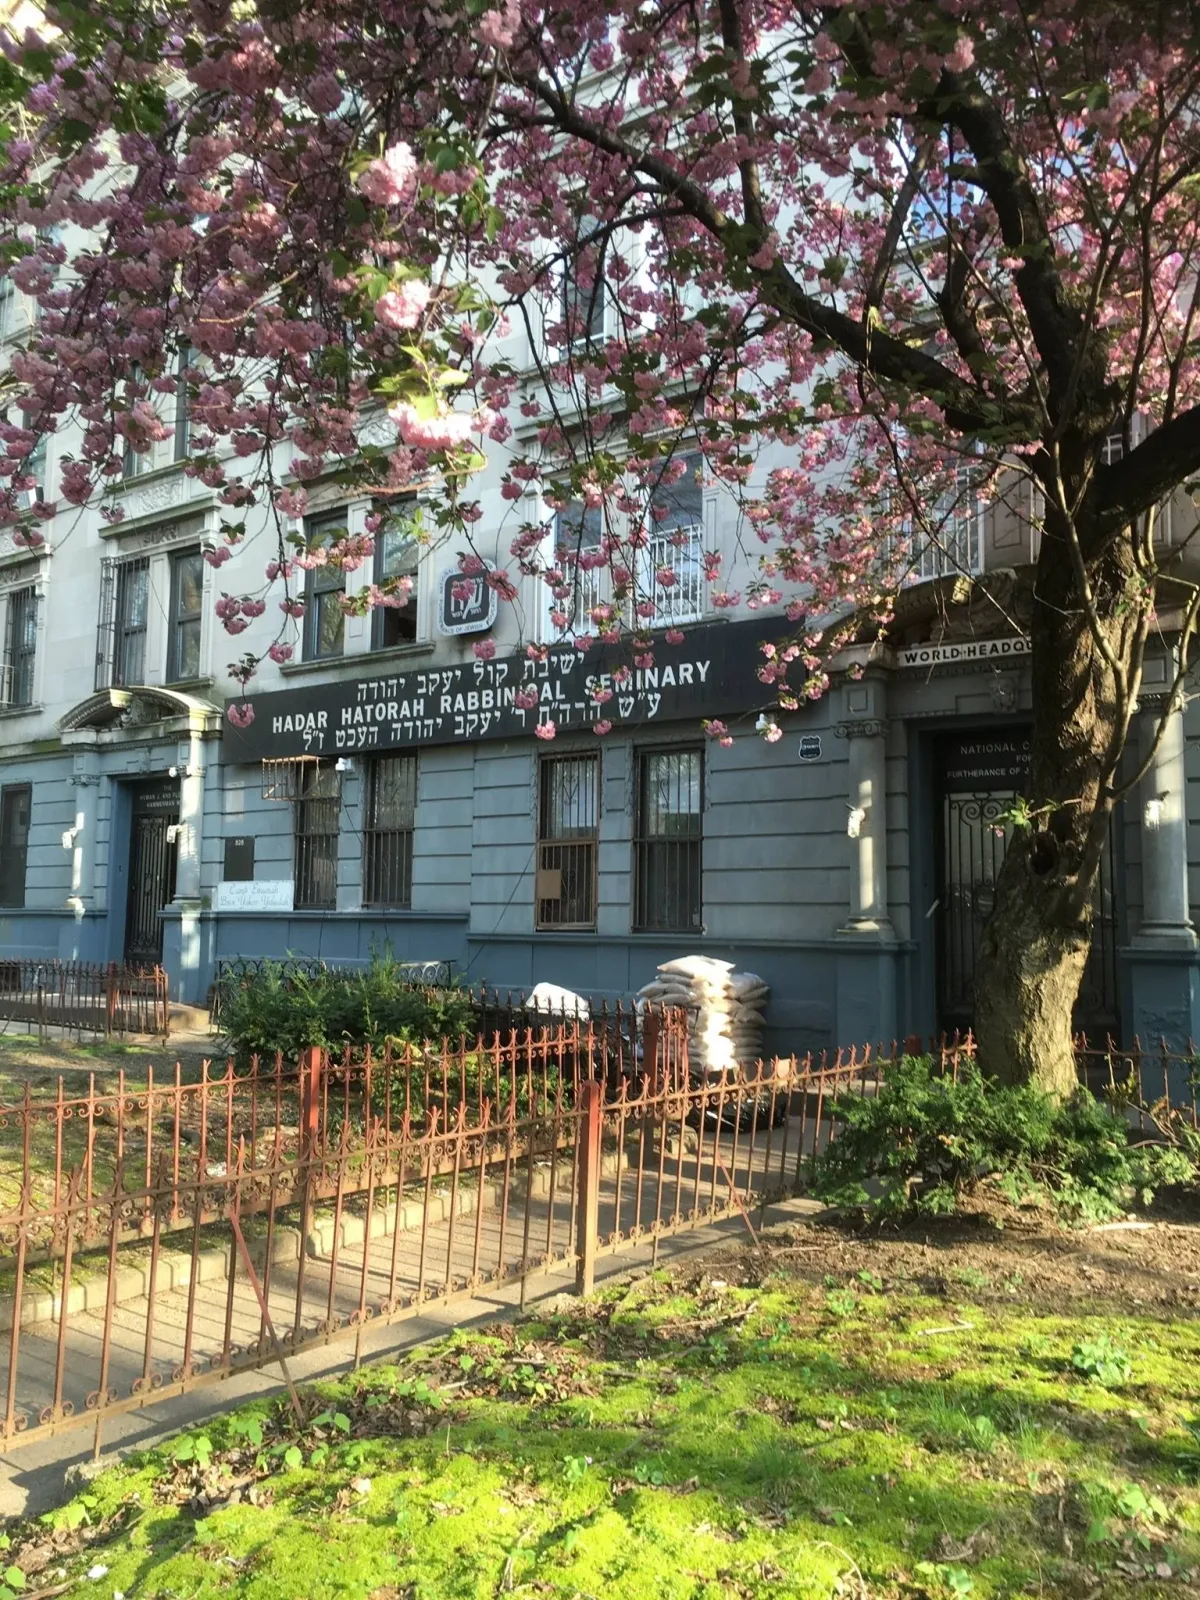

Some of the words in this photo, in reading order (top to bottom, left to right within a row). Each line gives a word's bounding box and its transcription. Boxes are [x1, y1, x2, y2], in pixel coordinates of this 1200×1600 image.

[523, 651, 585, 680] ישיבת
[904, 648, 960, 663] WORLD
[417, 669, 462, 696] יעקב
[473, 661, 509, 687] קול
[272, 711, 328, 734] HADAR
[341, 698, 425, 726] HATORAH
[440, 680, 566, 714] RABBINCAL
[584, 660, 711, 696] SEMINARY
[357, 677, 406, 701] יהודה
[390, 717, 443, 742] יהודה
[454, 710, 502, 738] יעקב
[335, 726, 379, 748] העכט
[960, 743, 1016, 755] NATIONAL
[947, 767, 1006, 779] FURTHERANCE
[1009, 767, 1020, 775] OF
